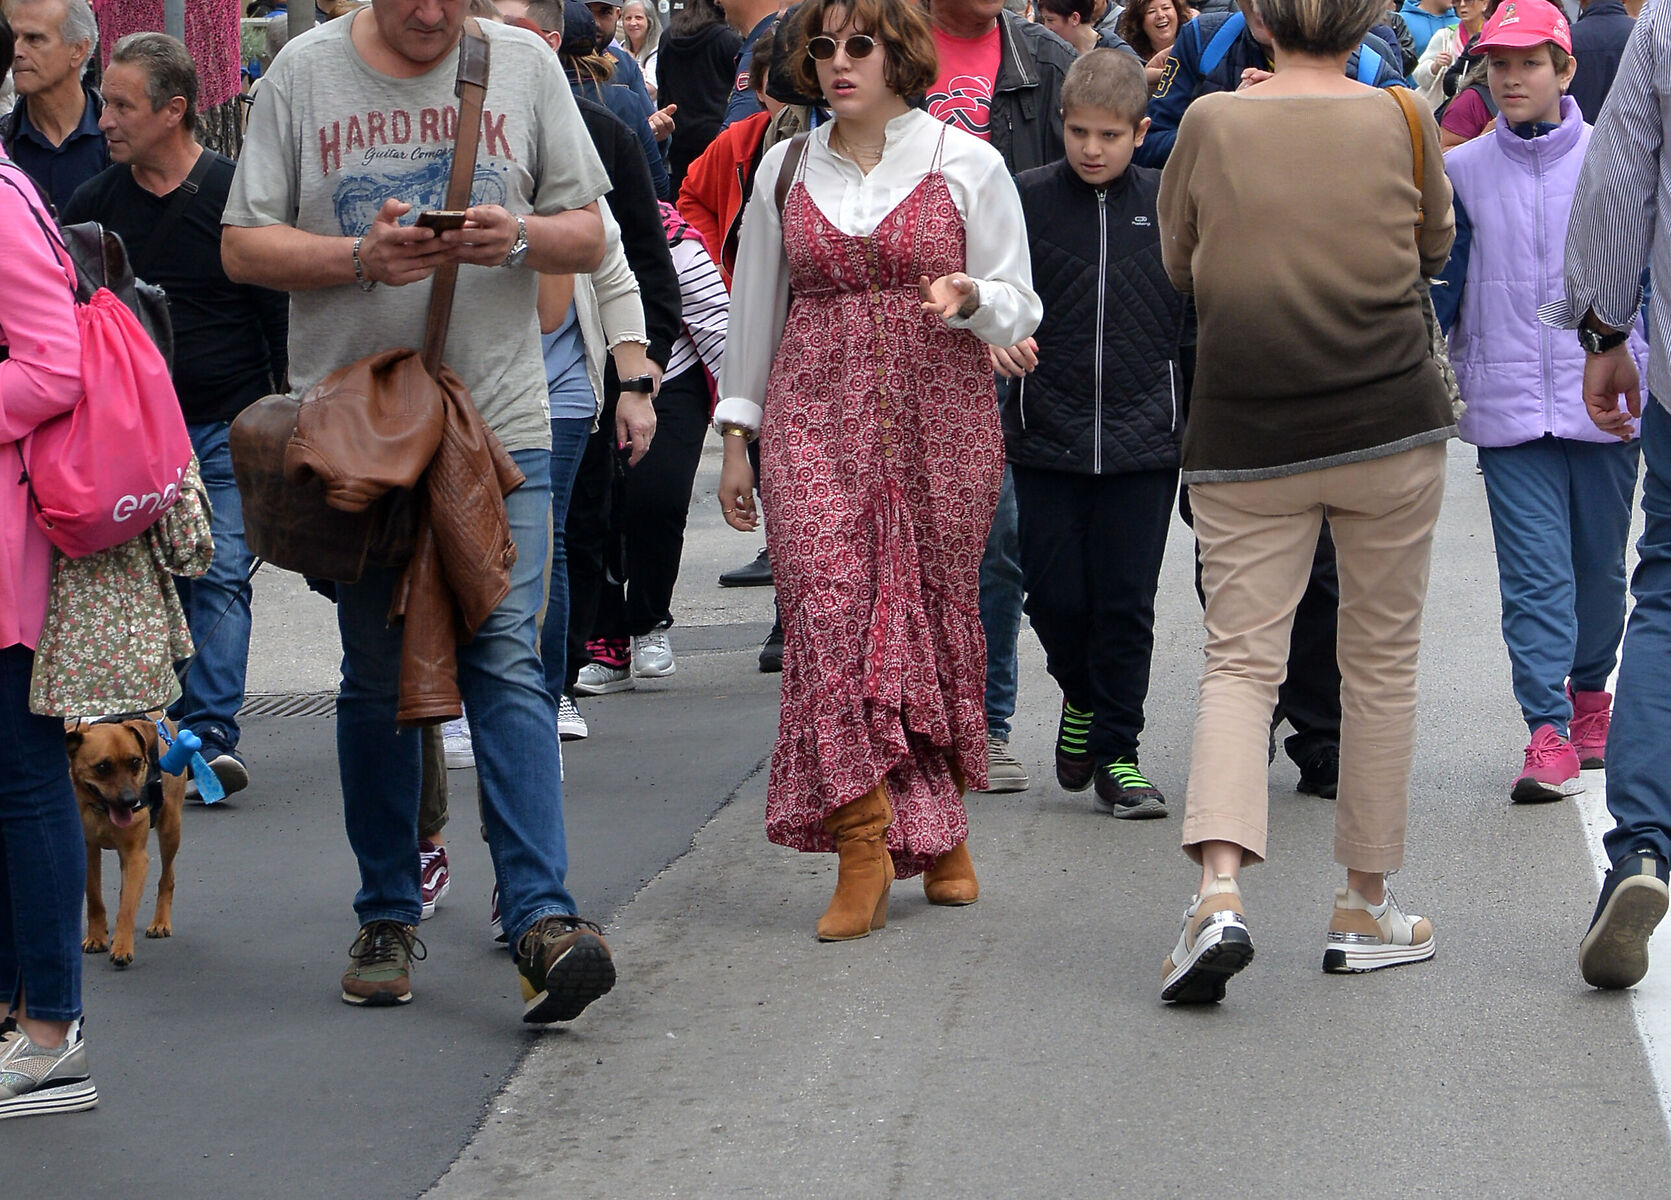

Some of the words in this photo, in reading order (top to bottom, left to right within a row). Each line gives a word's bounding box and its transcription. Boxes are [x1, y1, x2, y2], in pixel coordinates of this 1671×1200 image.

[319, 109, 411, 177] HARD
[420, 105, 518, 163] ROK
[362, 146, 409, 166] Guitar
